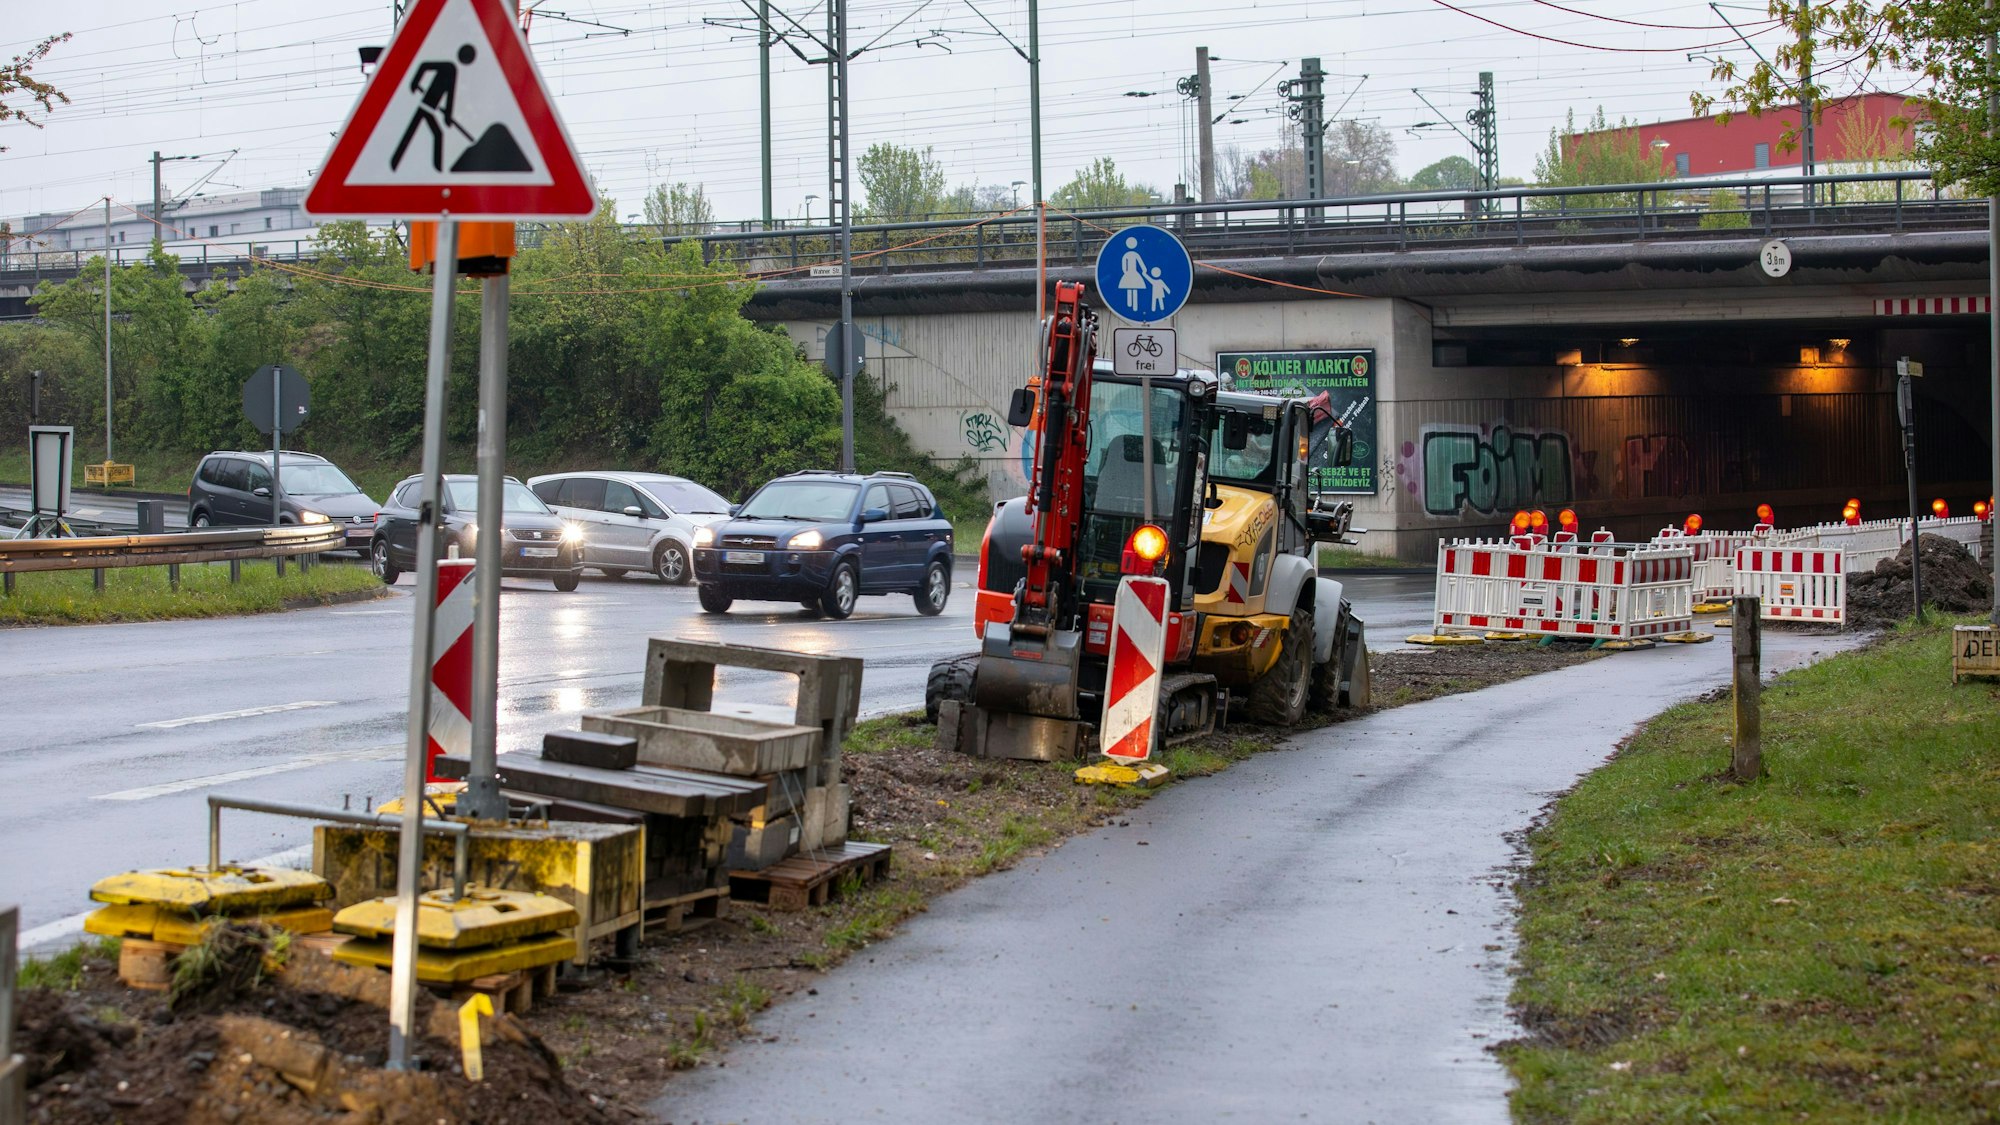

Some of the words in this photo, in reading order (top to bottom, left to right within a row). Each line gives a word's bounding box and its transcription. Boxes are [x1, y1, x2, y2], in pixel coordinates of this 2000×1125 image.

[1135, 359, 1155, 371] frei
[1253, 357, 1301, 375] KÖLNER
[1306, 359, 1350, 374] MARKT
[1306, 376, 1368, 387] SPEZIALITÄTEN
[1353, 396, 1370, 417] Fleisch
[1322, 467, 1347, 476] SEBZE
[1348, 467, 1359, 476] VE
[1361, 467, 1371, 476] ET
